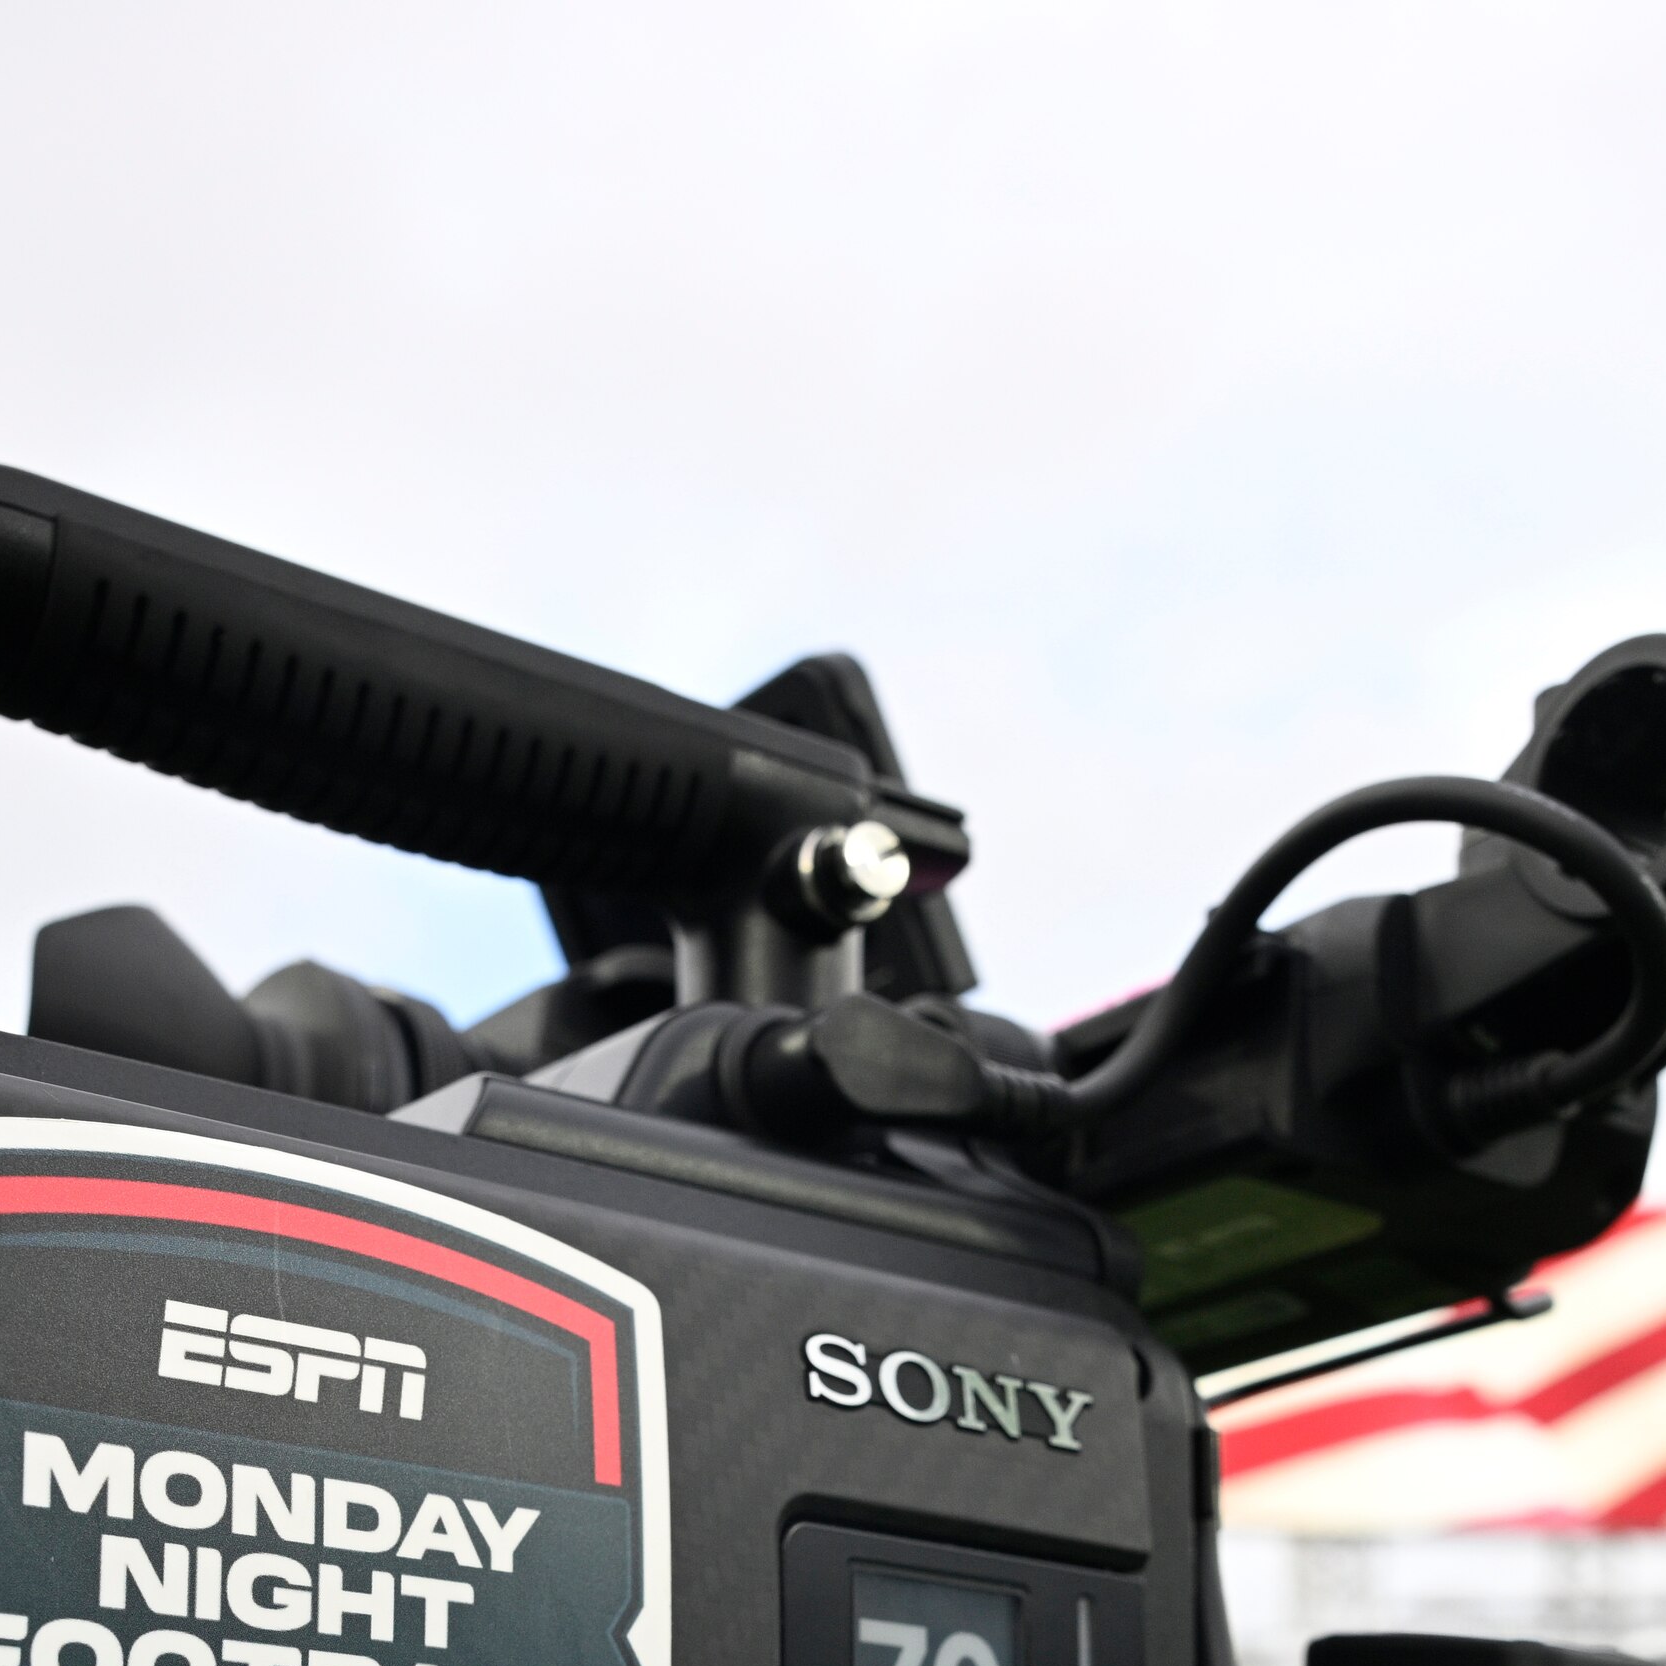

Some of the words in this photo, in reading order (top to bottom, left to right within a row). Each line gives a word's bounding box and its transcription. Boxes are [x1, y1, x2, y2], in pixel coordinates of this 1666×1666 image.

[158, 1299, 427, 1421] ESPN
[805, 1333, 1093, 1450] SONY
[22, 1431, 541, 1573] MONDAY
[99, 1534, 475, 1649] NIGHT
